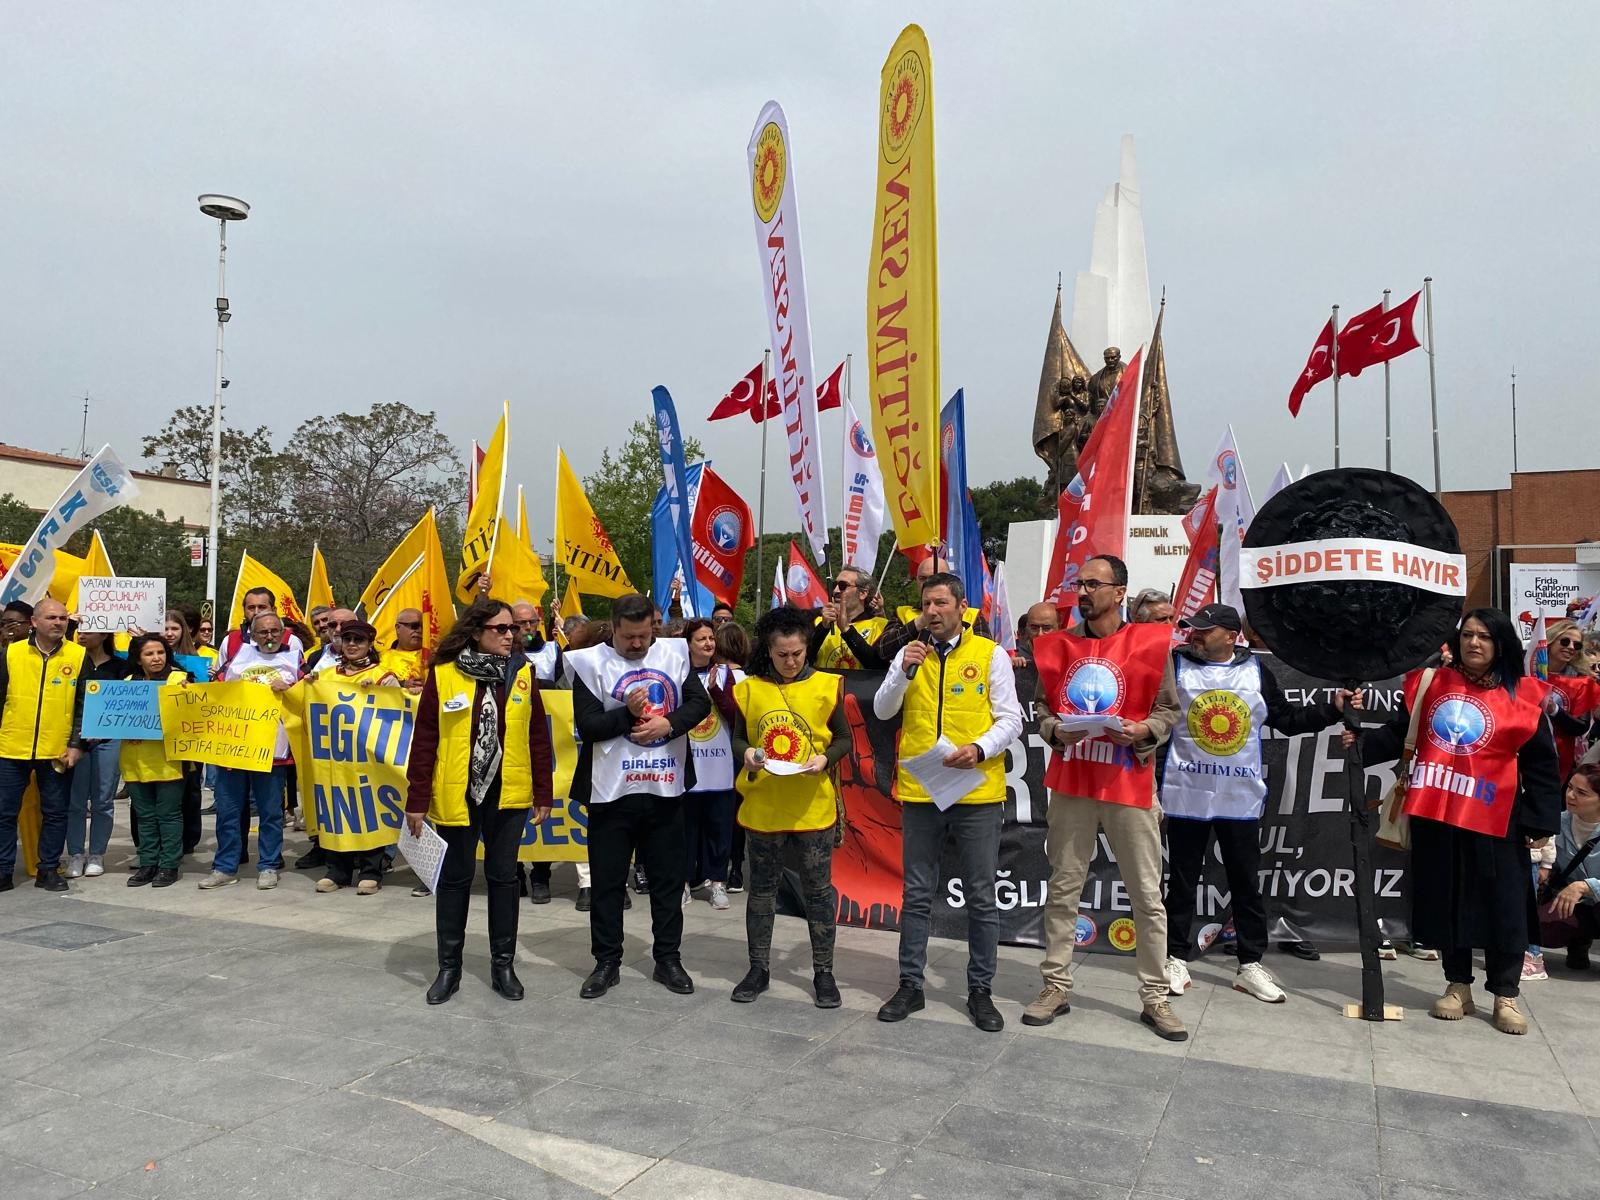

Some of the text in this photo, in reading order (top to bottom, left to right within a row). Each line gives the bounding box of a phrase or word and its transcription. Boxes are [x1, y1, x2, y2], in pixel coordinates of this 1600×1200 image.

[91, 463, 120, 498] KESK
[1129, 525, 1168, 538] GEMENLİK
[1256, 549, 1460, 588] ŞİDDETE HAYIR
[1535, 577, 1558, 585] Frida
[1535, 584, 1580, 592] Kahlo'nun
[1535, 598, 1567, 607] Sergisi
[102, 684, 150, 696] İNSANCA
[168, 691, 208, 707] TÜM
[200, 705, 280, 722] SORUMLULAR
[310, 692, 414, 767] EĞİTİ
[622, 757, 676, 772] BİRLEŞİK
[1178, 760, 1256, 778] EĞİTİM SEN
[626, 772, 675, 784] KAMU-İŞ
[314, 775, 405, 835] ANİS
